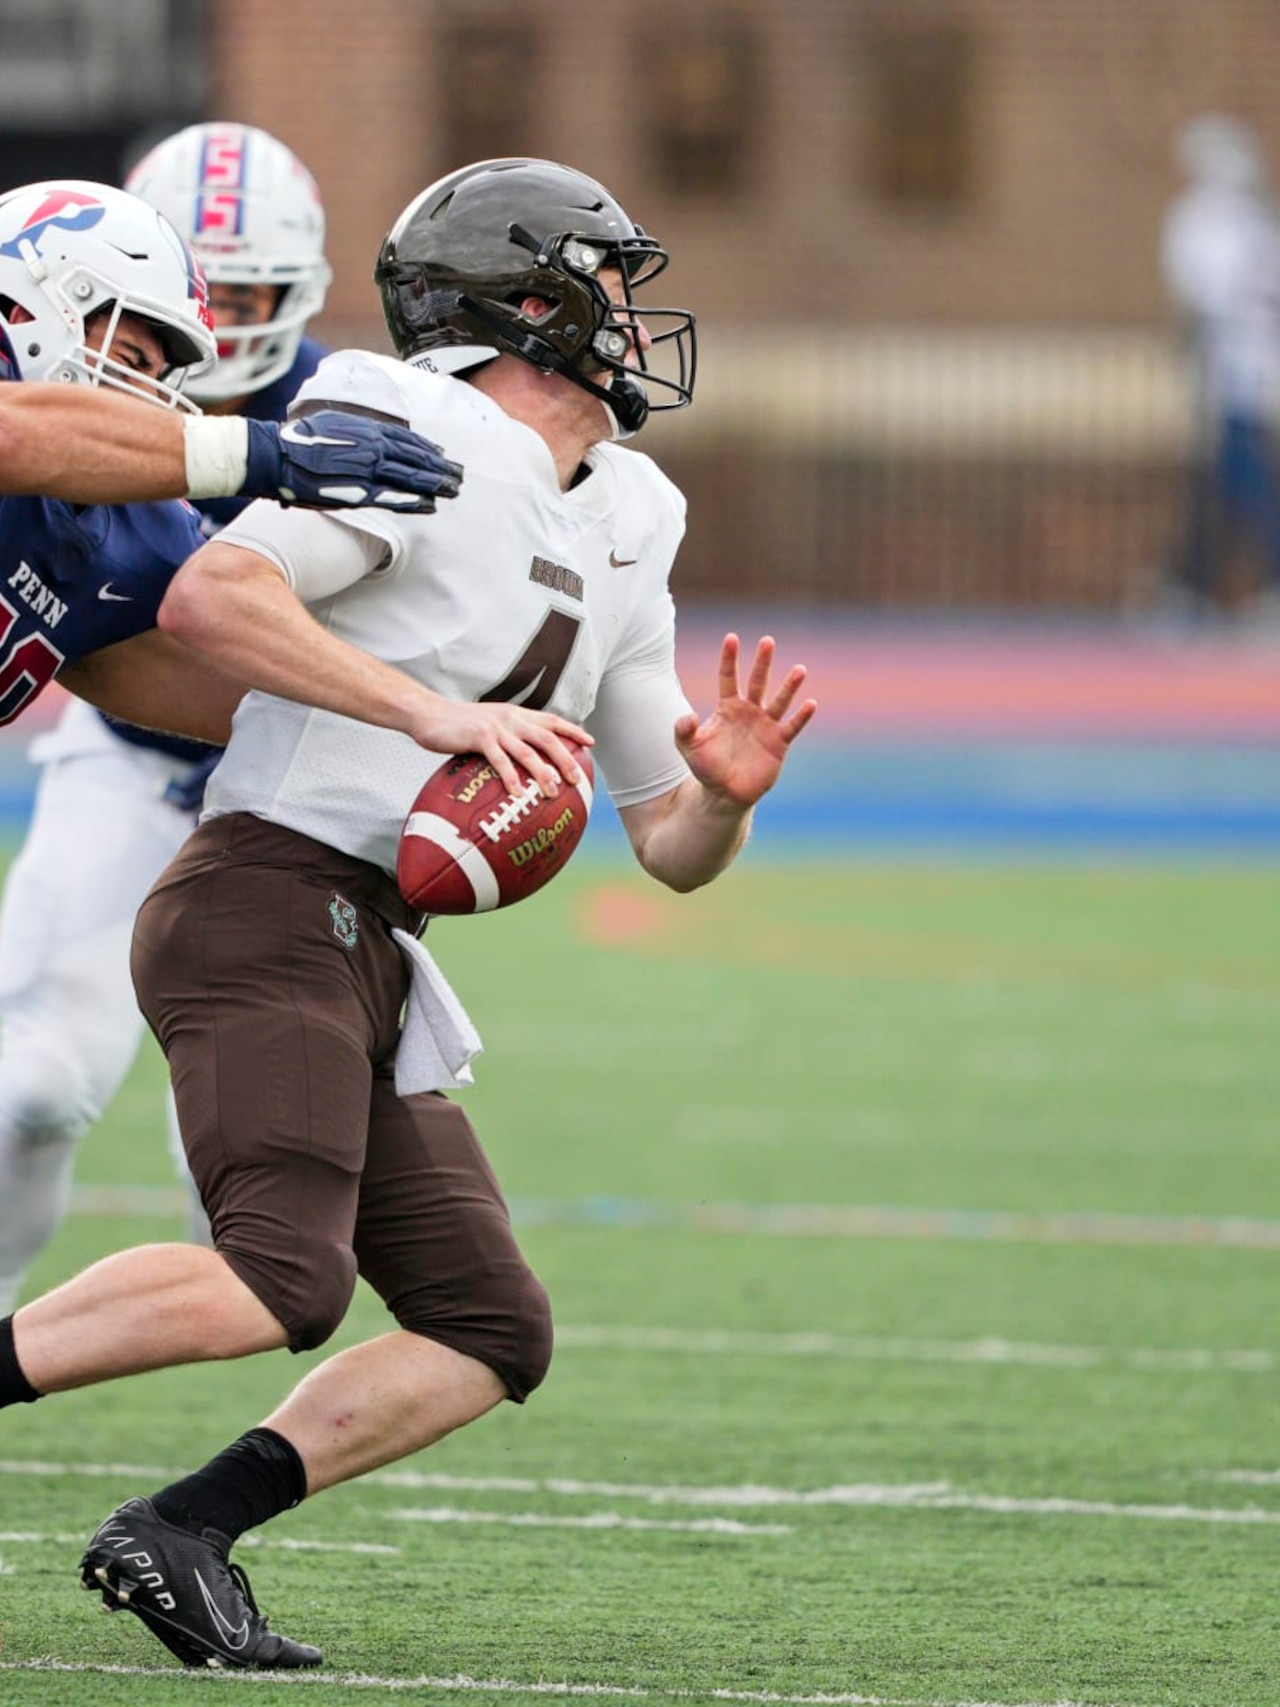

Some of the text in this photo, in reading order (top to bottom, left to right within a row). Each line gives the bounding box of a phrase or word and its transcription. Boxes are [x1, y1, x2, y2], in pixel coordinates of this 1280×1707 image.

[7, 559, 70, 630] PENN
[528, 554, 585, 603] BROWN
[472, 603, 585, 711] 4
[507, 807, 574, 866] Wilson
